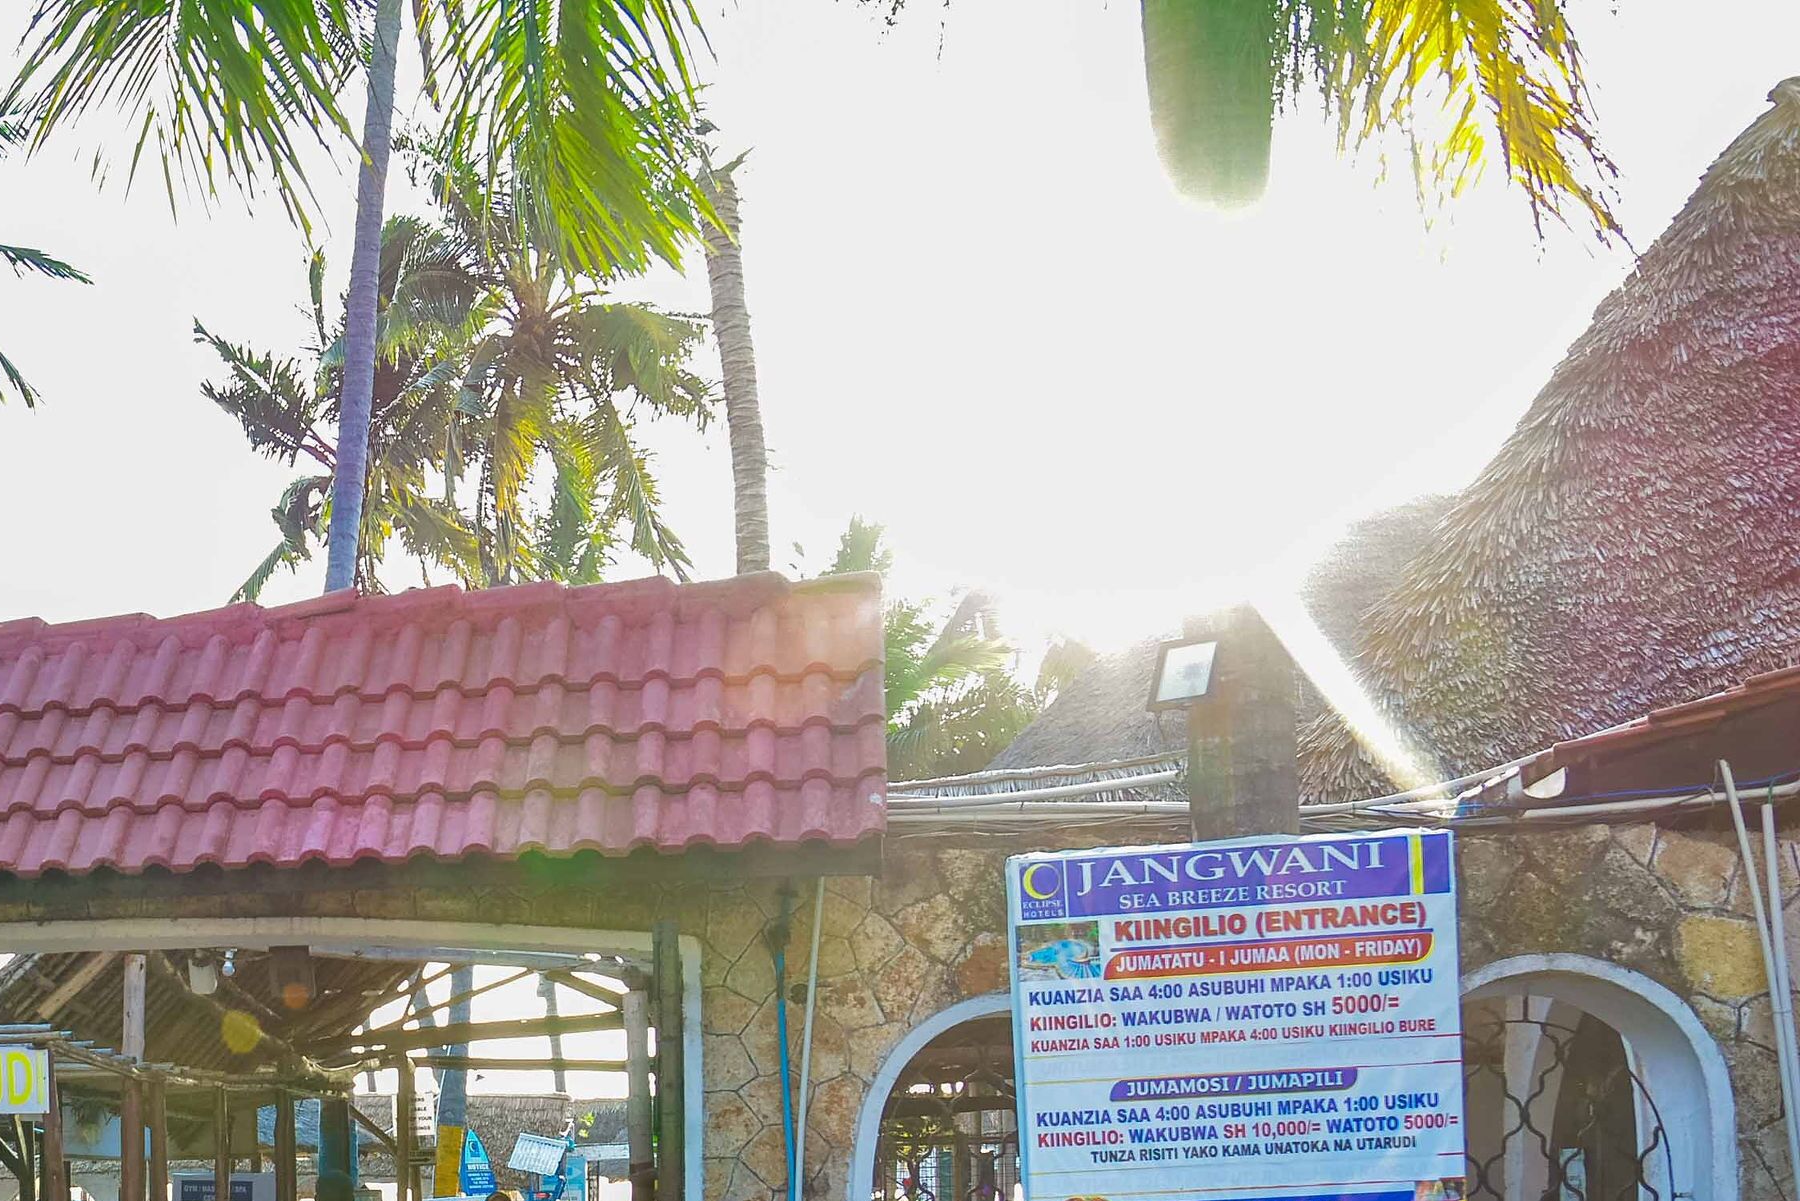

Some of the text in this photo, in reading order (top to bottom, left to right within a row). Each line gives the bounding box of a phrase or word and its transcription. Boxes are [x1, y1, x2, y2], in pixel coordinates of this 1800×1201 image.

[1077, 841, 1384, 896] JANGWANI
[1023, 900, 1062, 909] ECLIPSE
[1119, 880, 1346, 910] SEA BREEZE RESORT
[1023, 910, 1065, 918] HOTELS
[1114, 901, 1427, 942] KIINGILIO (ENTRANCE)
[1116, 951, 1204, 973] JUMATATU
[1230, 947, 1290, 965] JUMAA
[1294, 943, 1339, 965] (MON
[1355, 938, 1422, 958] FRIDAY)
[1029, 968, 1433, 1006] KUANZIA SAA 4:00 ASUBUHI MPAKA 1:00 USIKU
[1030, 1013, 1117, 1031] KIINGILIO:
[1121, 1007, 1211, 1027] WAKUBWA
[1225, 1002, 1297, 1021] WATOTO
[1302, 1001, 1326, 1017] SH
[1331, 994, 1400, 1015] 5000/=
[1031, 1019, 1436, 1053] KUANZIA SAA 1:00 USIKU MPAKA 4:00 USIKU KIINGILIO BURE
[1126, 1077, 1229, 1097] JUMAMOSI
[1247, 1071, 1343, 1091] JUMAPILI
[1036, 1092, 1439, 1127] KUANZIA SAA 4:00 ASUBUHI MPAKA 1:00 USIKU
[1037, 1113, 1459, 1147] KIINGILIO: WAKUBWA SH 10,000/= WATOTO 5000/=
[1091, 1136, 1417, 1164] TUNZA RISITI YAKO KAMA UNATOKA NA UTARUDI
